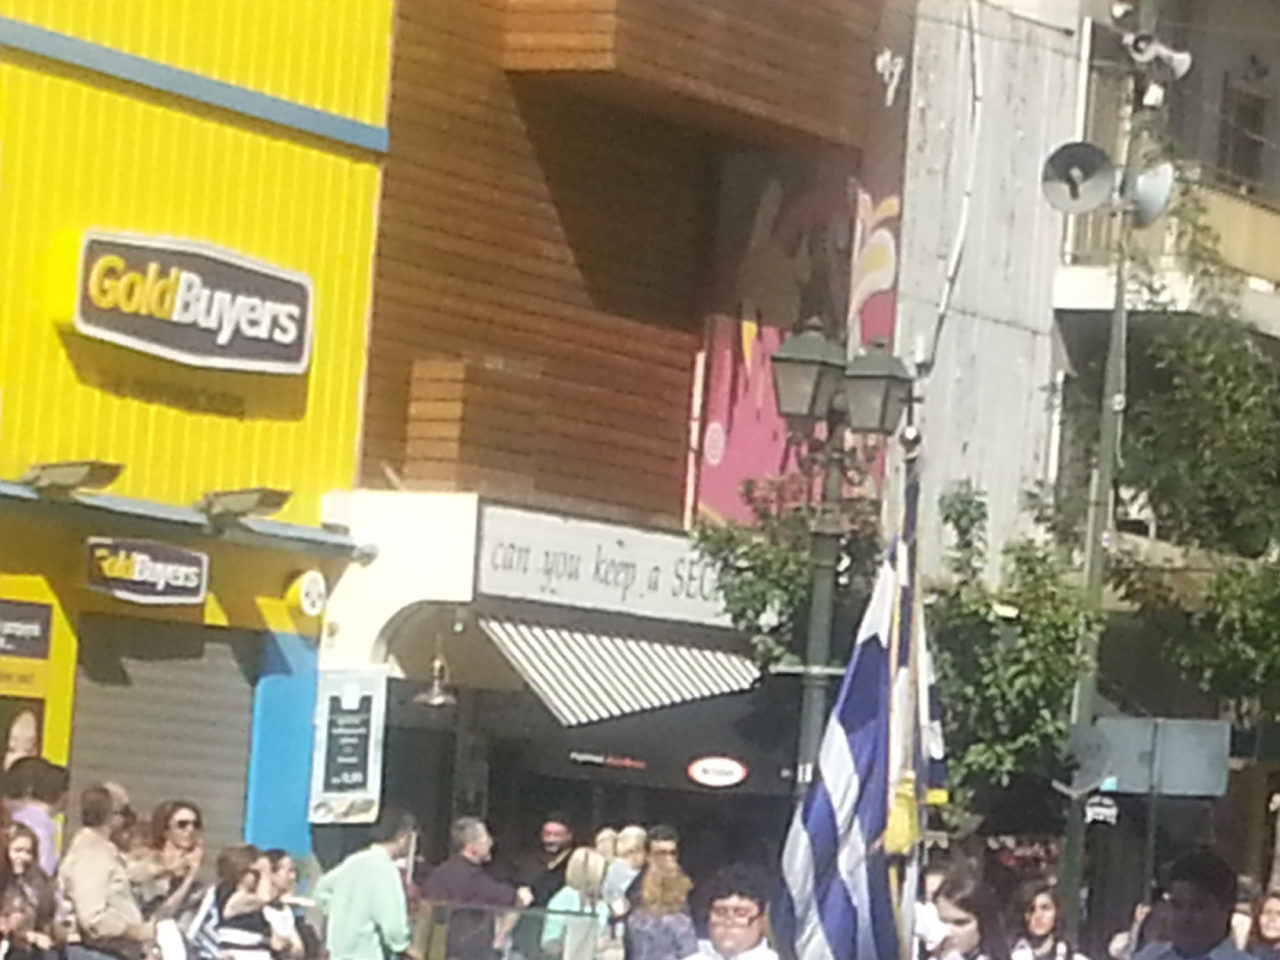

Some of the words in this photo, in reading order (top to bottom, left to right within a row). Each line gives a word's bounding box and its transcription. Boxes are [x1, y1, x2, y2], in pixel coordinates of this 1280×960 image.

[88, 254, 301, 345] GoldBuyers
[491, 542, 530, 575] can
[543, 549, 582, 586] you
[593, 544, 637, 602] keep
[648, 566, 661, 593] a
[672, 556, 721, 602] SEC
